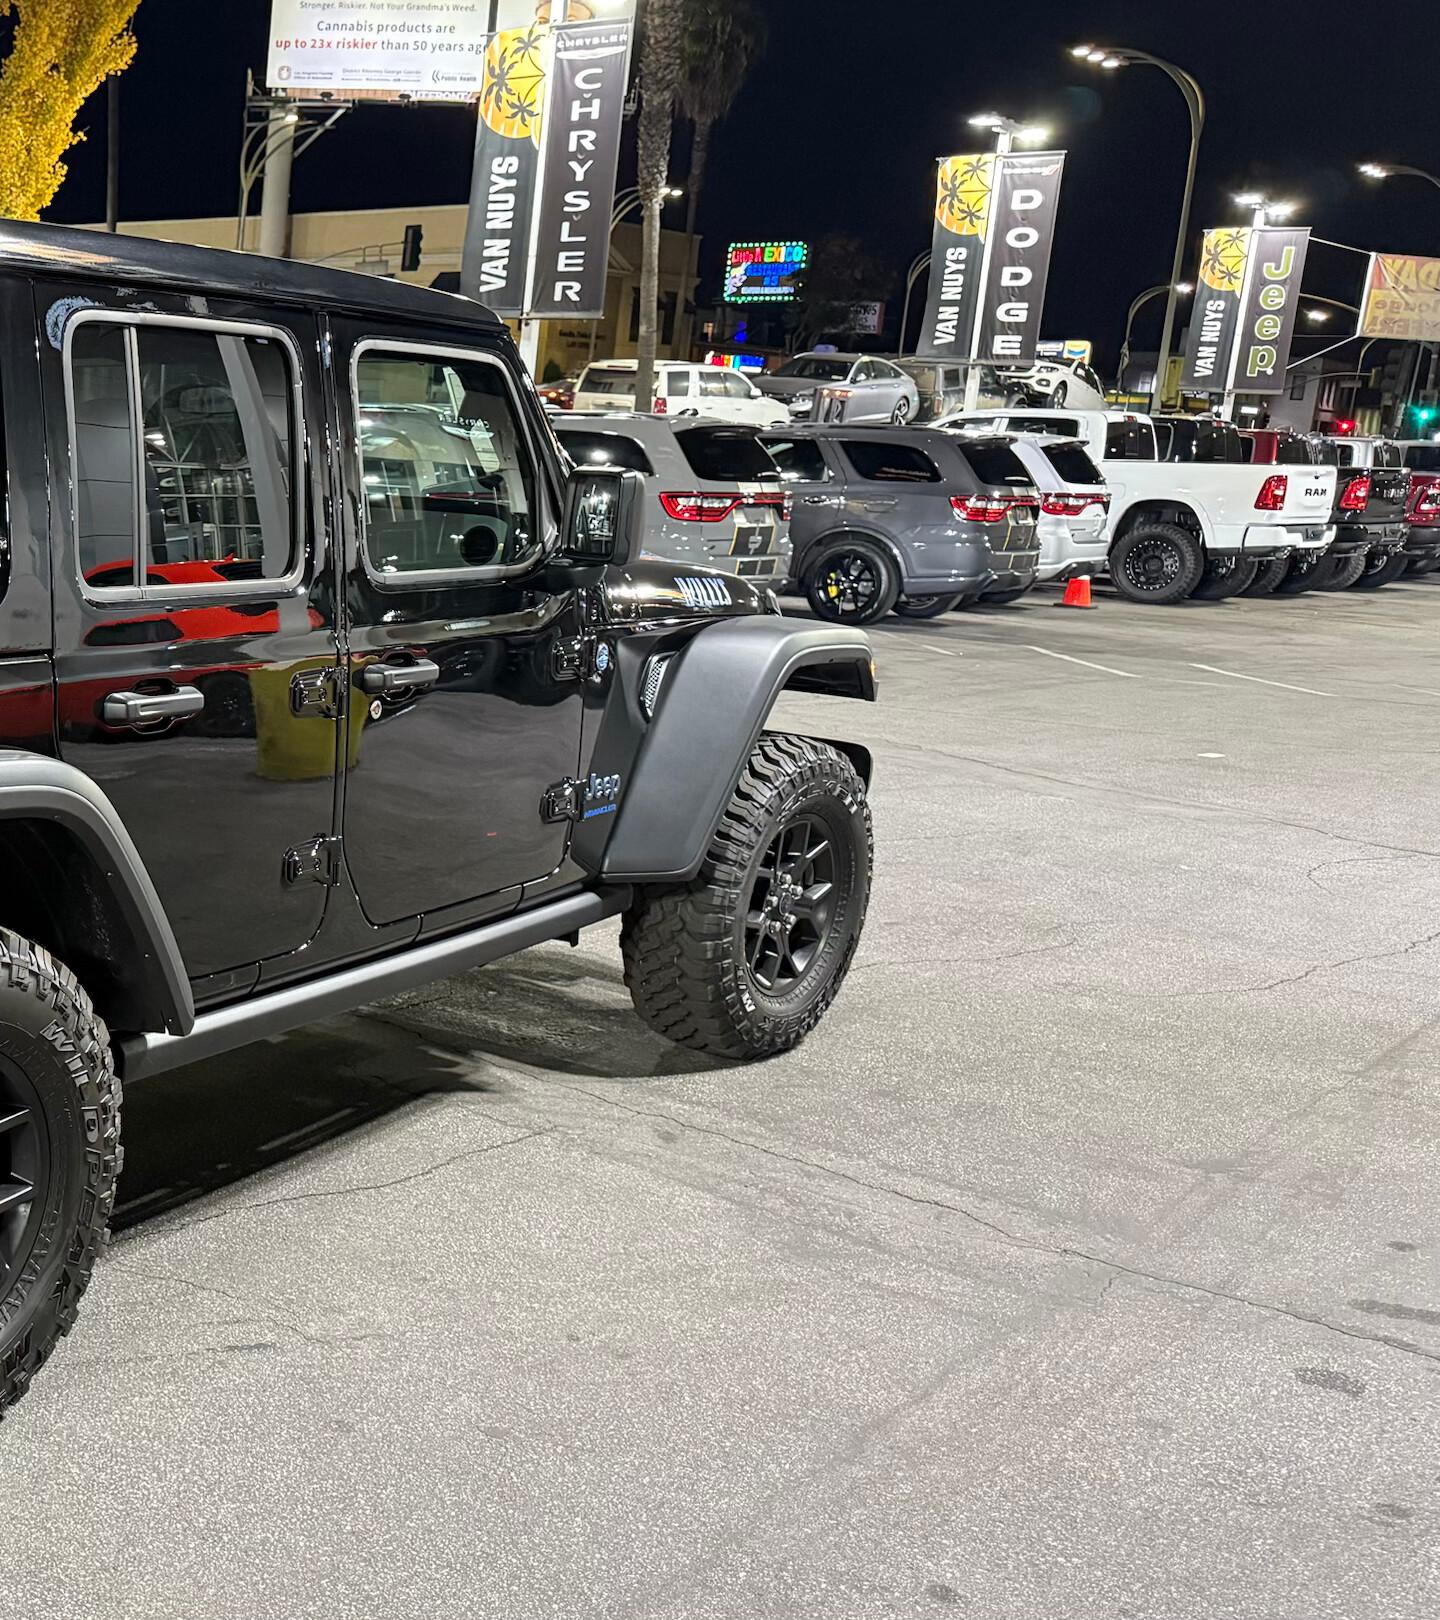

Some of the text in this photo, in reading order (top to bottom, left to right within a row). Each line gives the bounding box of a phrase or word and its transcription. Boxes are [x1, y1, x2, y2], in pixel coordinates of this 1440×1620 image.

[299, 1, 478, 12] Stronger. Riskier. Not Your Grandma's Weed.
[317, 20, 456, 34] Cannabis products are
[556, 33, 628, 49] CHRYSLER
[275, 39, 291, 50] up
[295, 38, 307, 49] to
[311, 39, 332, 49] 23x
[336, 38, 378, 50] riskier
[381, 39, 410, 51] than
[413, 40, 428, 51] 50
[430, 42, 464, 54] years
[553, 67, 604, 302] CHRYSLER
[479, 155, 520, 293] VAN NUYS
[933, 247, 968, 345] VAN NUYS
[992, 188, 1044, 356] DODGE
[1193, 300, 1226, 377] VAN NUYS
[1246, 246, 1296, 378] Jeep
[1304, 488, 1327, 497] RAM
[584, 772, 621, 801] Jeep
[39, 1018, 102, 1318] WILDPEAK
